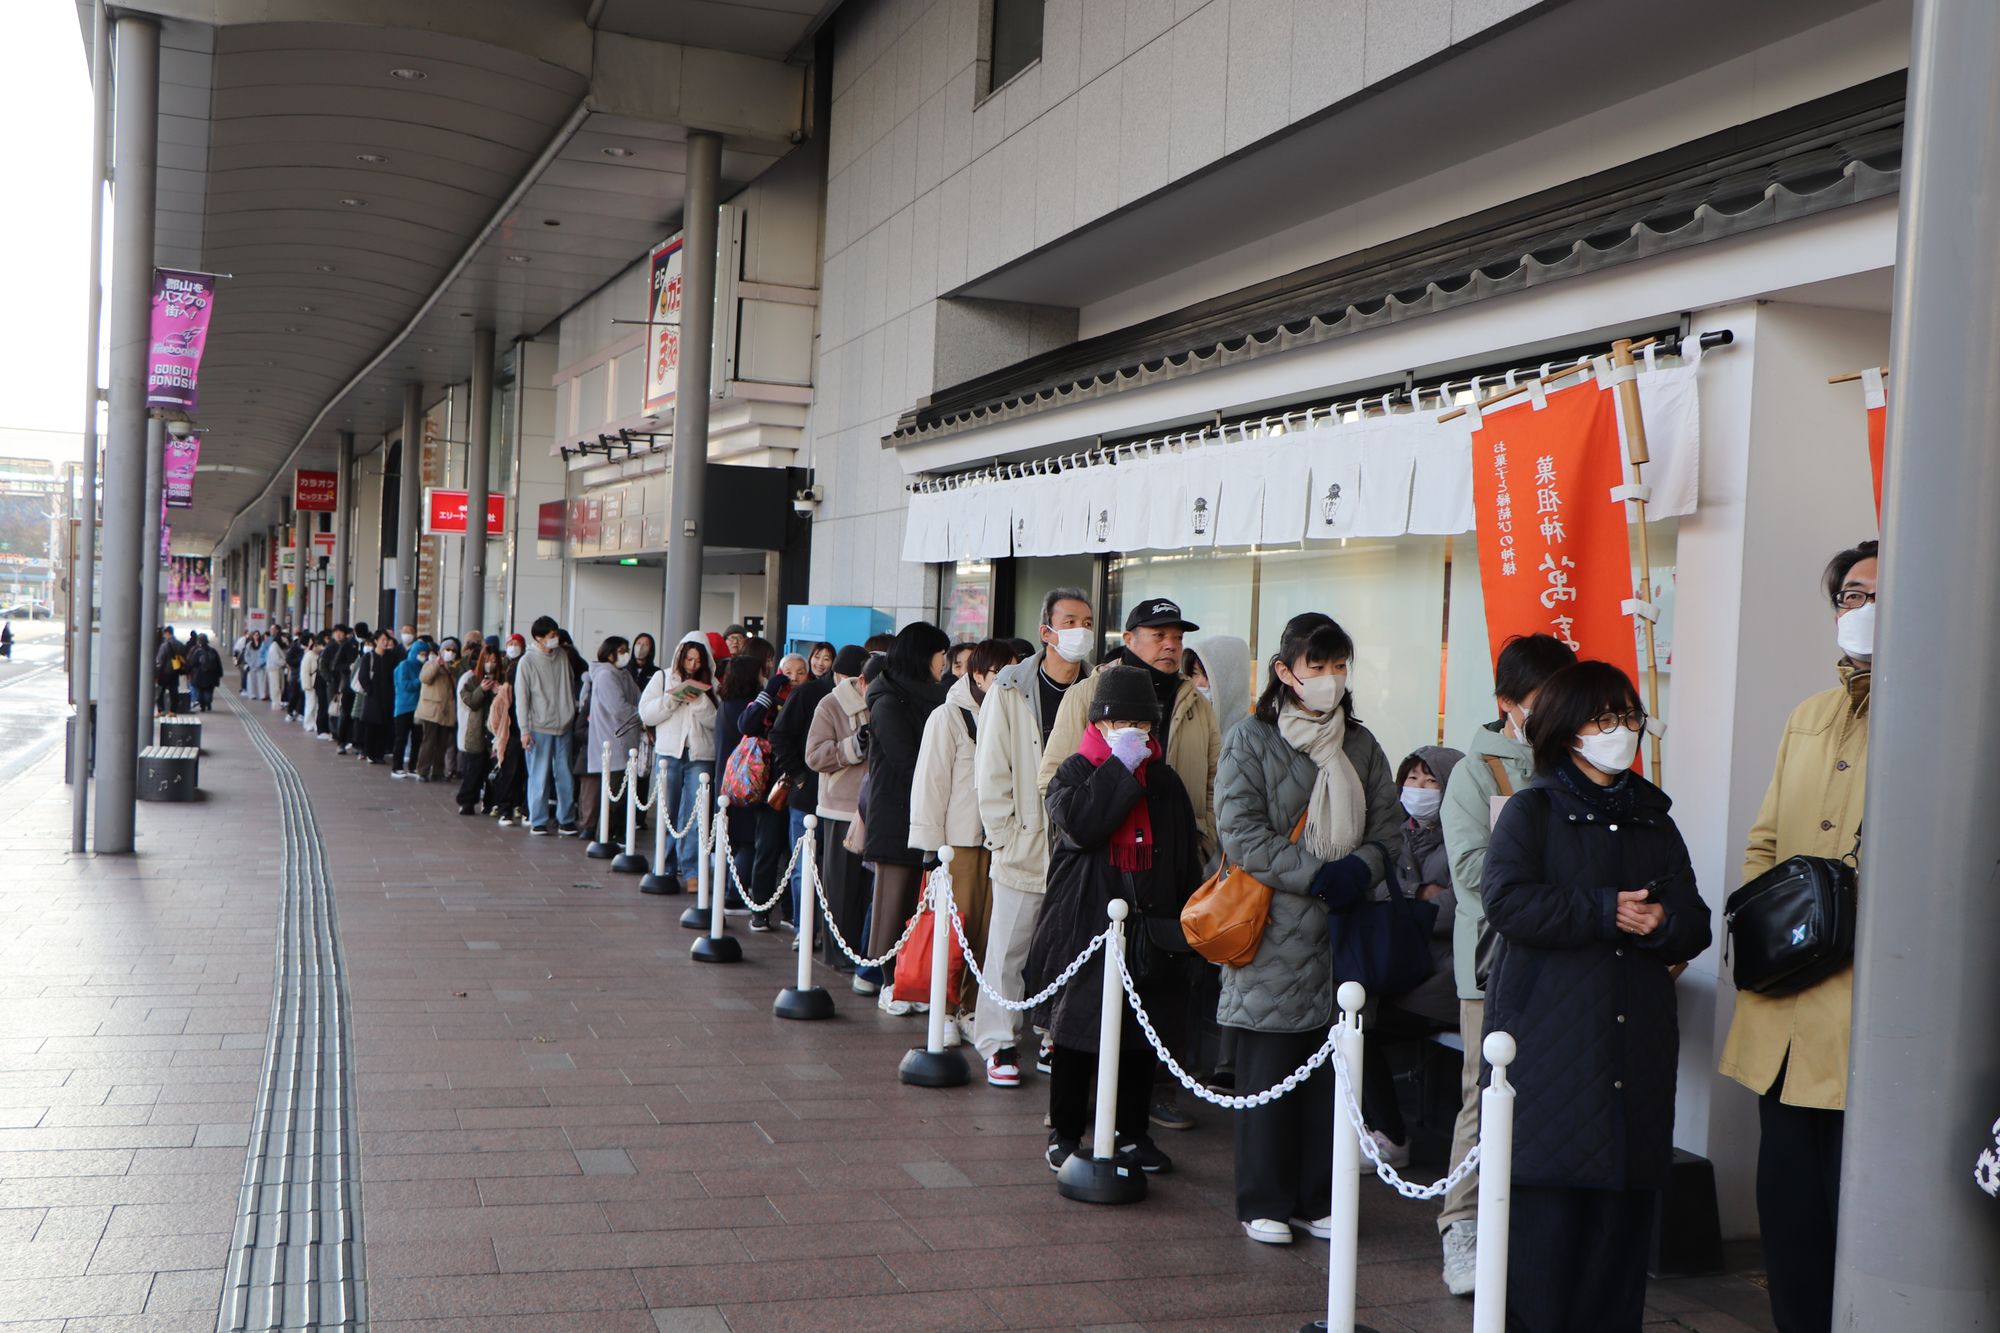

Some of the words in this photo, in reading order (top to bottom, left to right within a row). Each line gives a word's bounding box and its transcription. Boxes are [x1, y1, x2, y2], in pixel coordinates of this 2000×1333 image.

[165, 278, 204, 293] 郡山を
[654, 267, 666, 290] 2F
[159, 290, 207, 308] バスケの
[155, 364, 193, 378] GO!GO!
[149, 375, 196, 390] BONDS!!
[300, 478, 335, 489] カラオケ
[438, 511, 497, 523] エリート社
